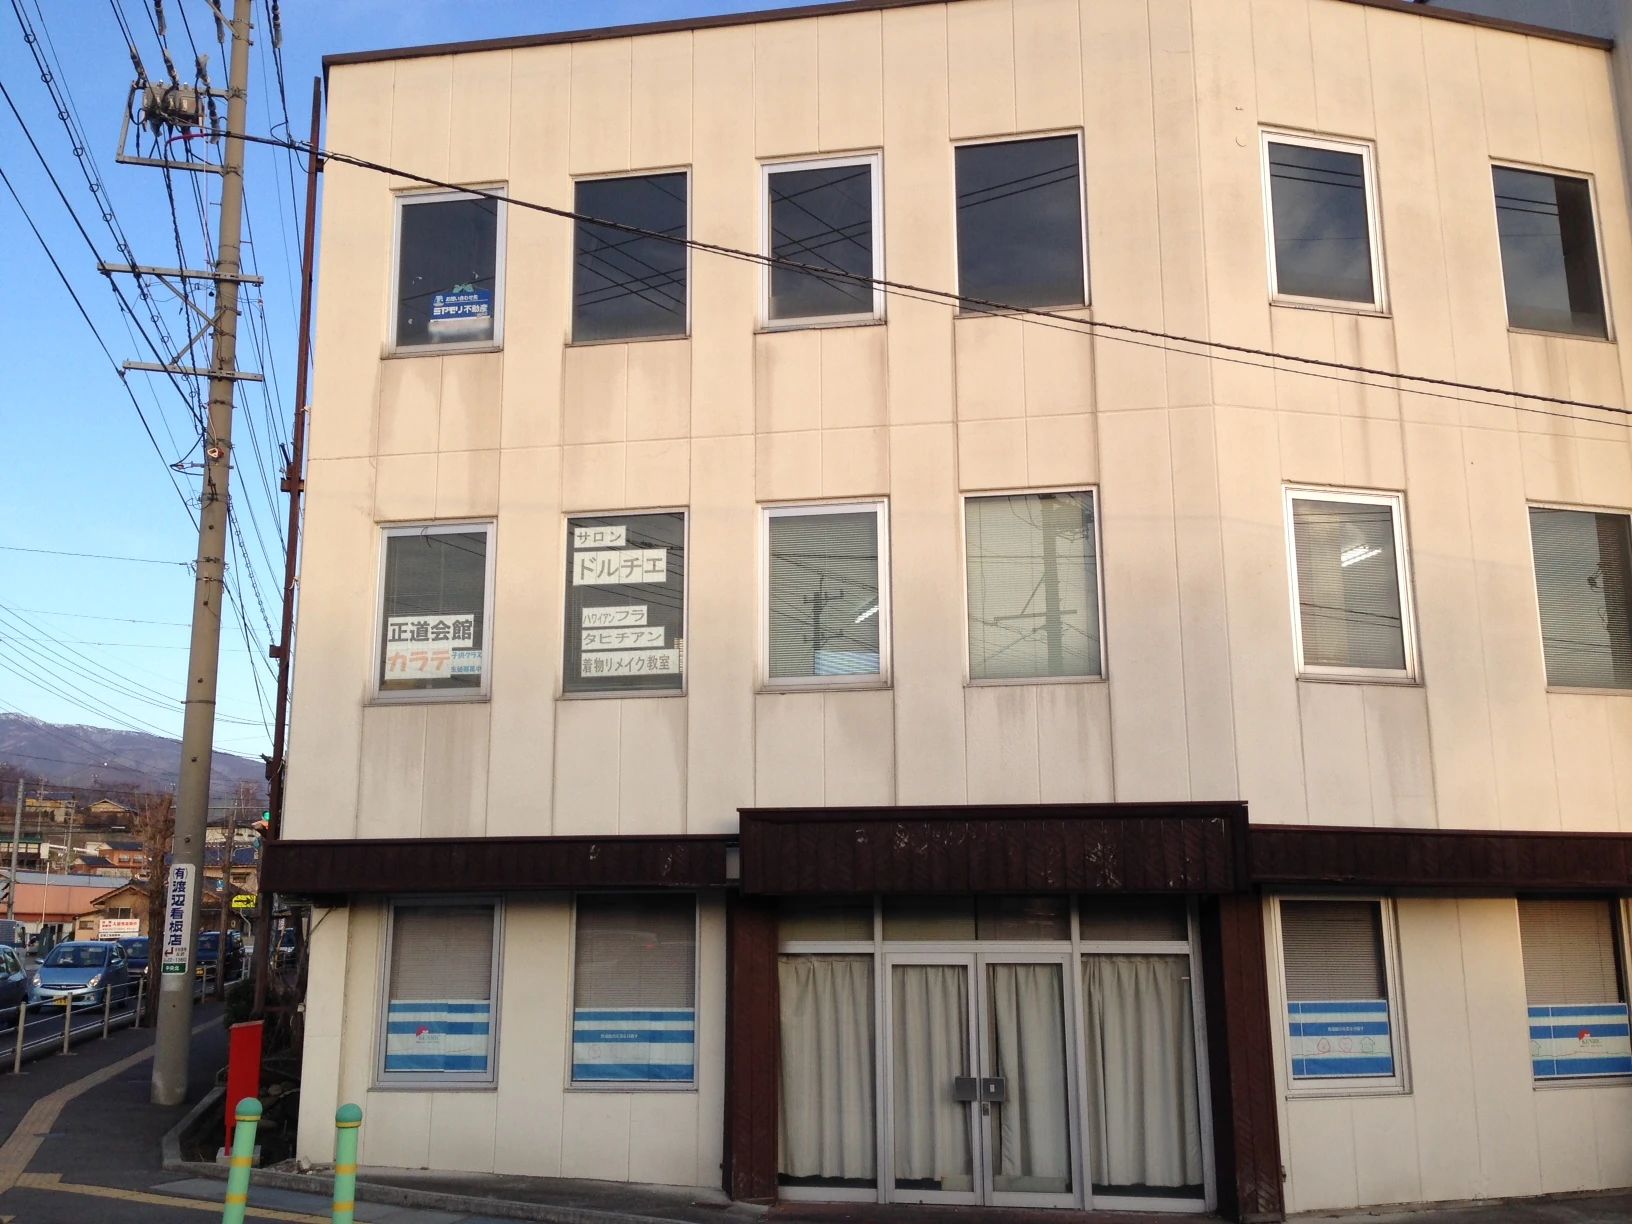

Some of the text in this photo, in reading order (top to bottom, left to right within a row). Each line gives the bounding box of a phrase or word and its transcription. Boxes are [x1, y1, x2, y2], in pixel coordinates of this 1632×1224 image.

[576, 531, 622, 545] サロン
[388, 619, 473, 643] 正道会館
[583, 631, 662, 646] タヒチアン
[386, 650, 451, 673] カラテ
[582, 654, 671, 673] 着物リメイク教室
